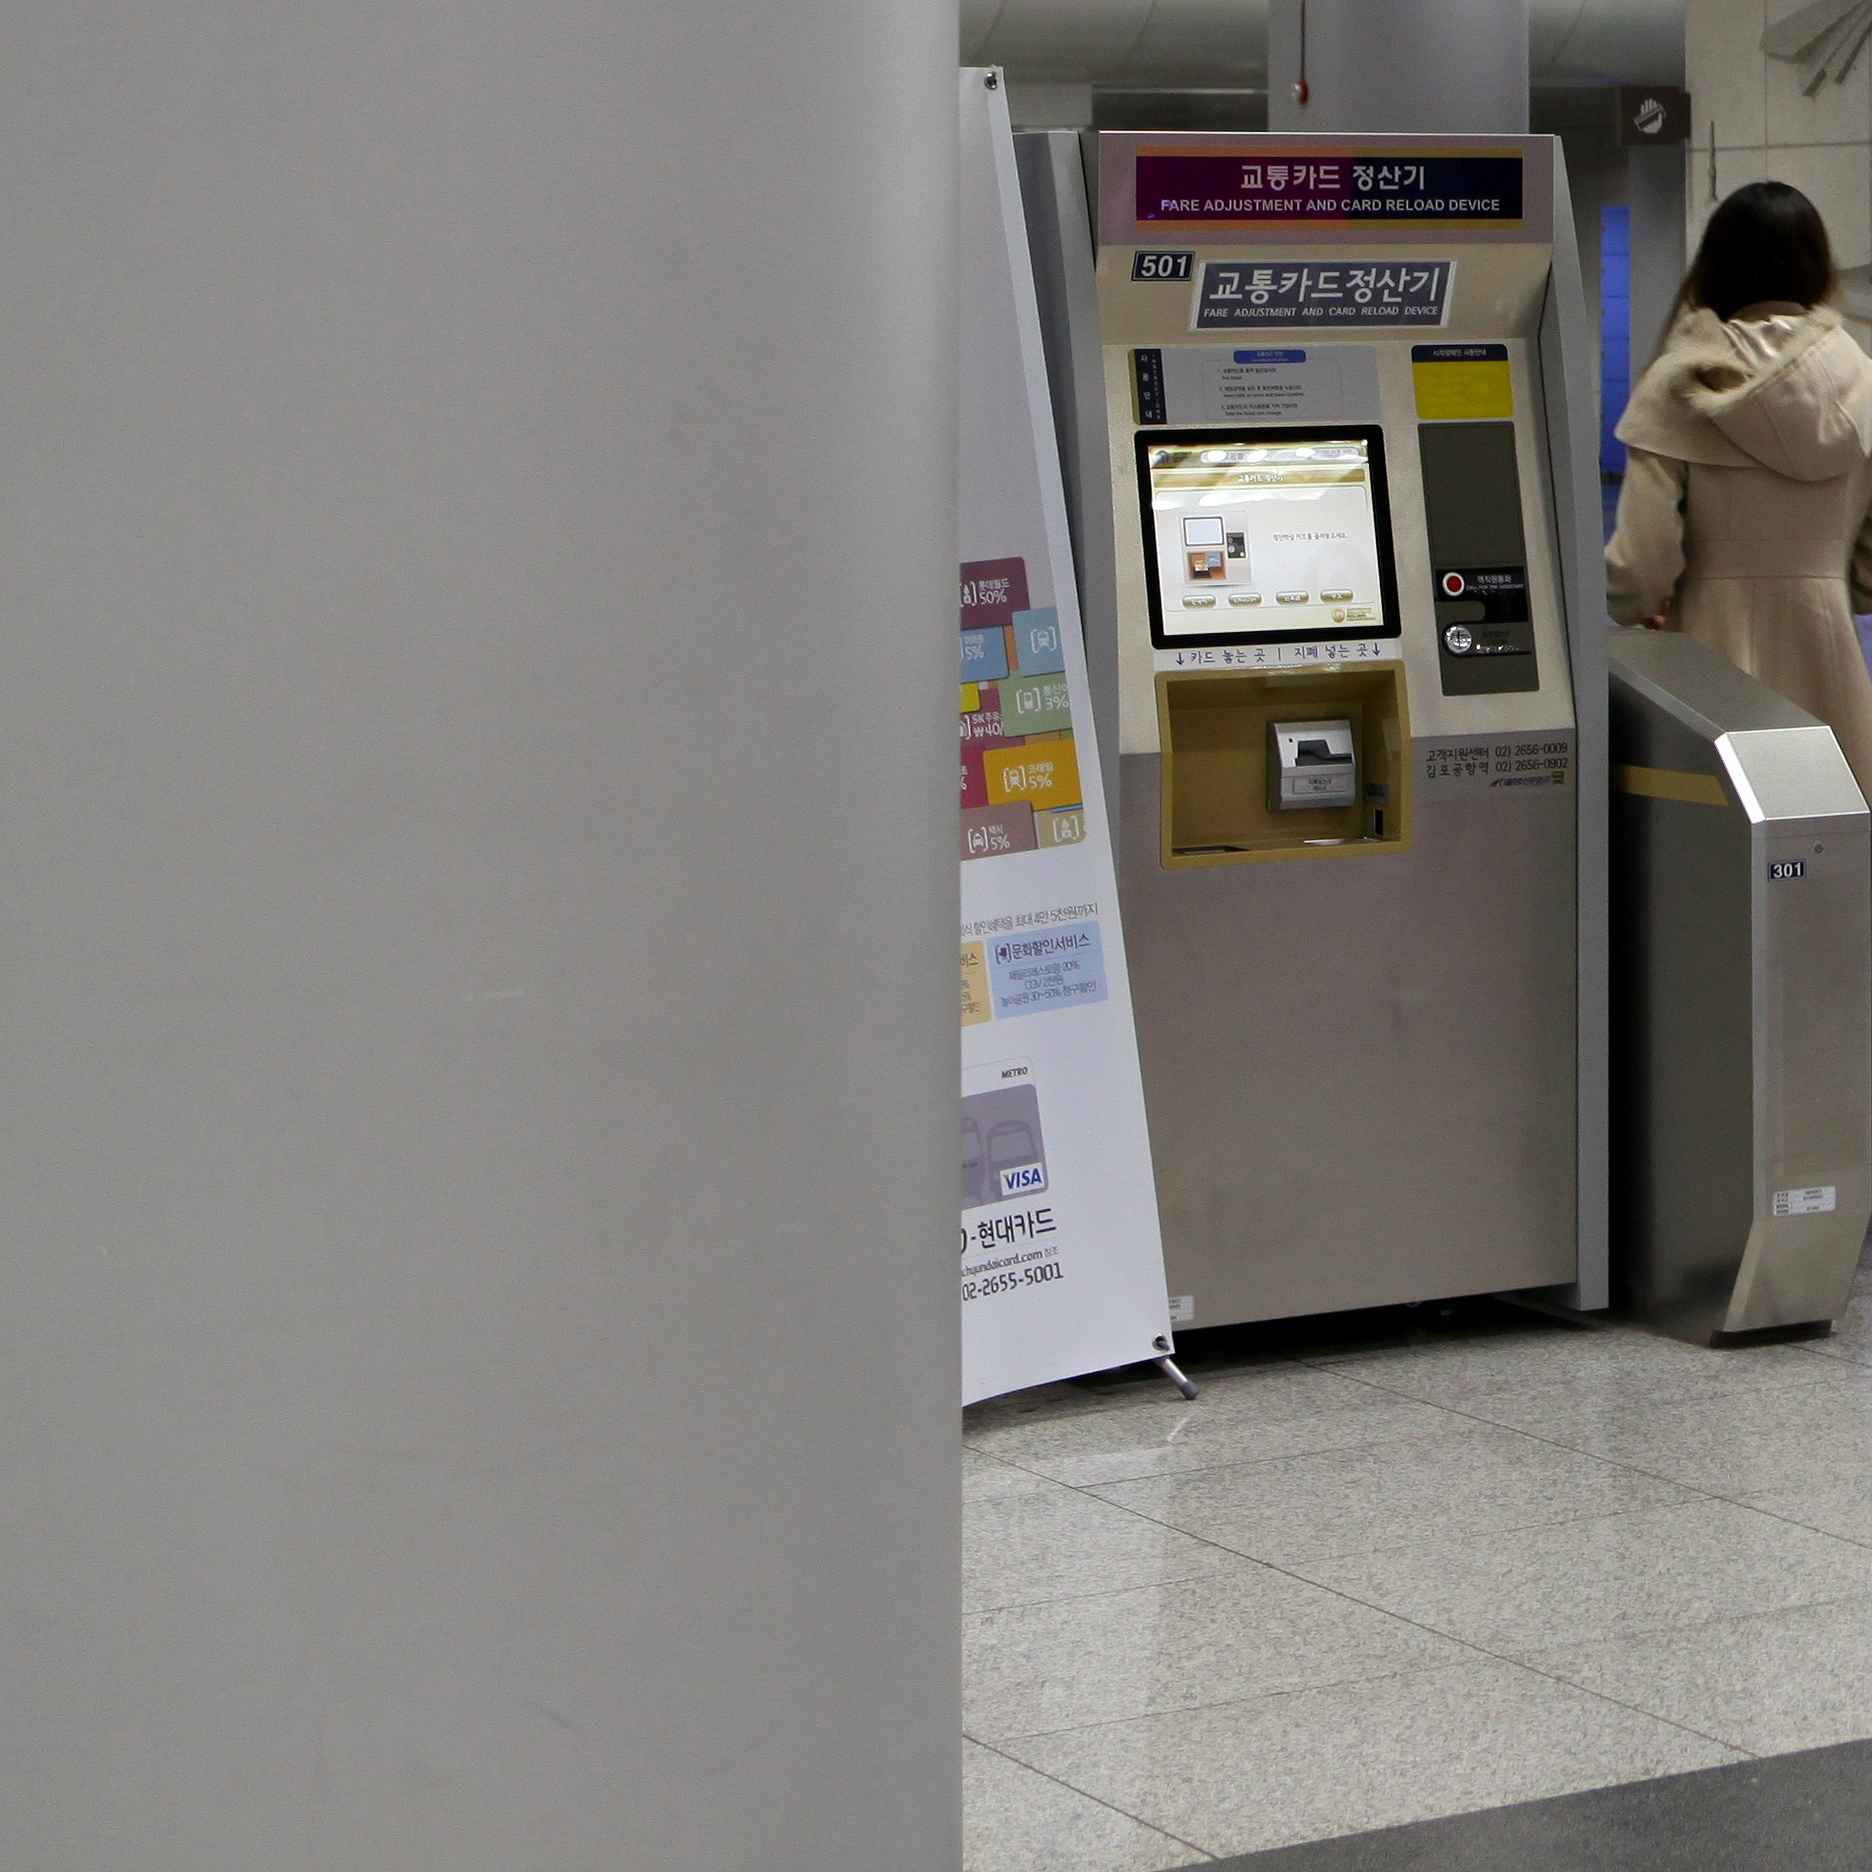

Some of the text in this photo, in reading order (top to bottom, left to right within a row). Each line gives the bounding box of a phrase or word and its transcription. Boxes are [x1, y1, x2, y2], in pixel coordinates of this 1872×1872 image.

[1240, 165, 1425, 192] 교통카드 정산기
[1161, 199, 1500, 212] FARE ADJUSTMENT AND CARD RELOAD DEVICE
[1141, 255, 1189, 277] 501
[1209, 269, 1439, 304] 교통카드정산기
[1204, 306, 1438, 319] FARE ADJUSTMENT AND CARD RELOAD DEVICE
[980, 589, 1007, 605] 50%
[1191, 648, 1265, 664] 카드 놓는 곳
[1294, 643, 1370, 659] 지폐 넣는 곳
[1045, 696, 1070, 711] 3%
[1495, 746, 1511, 758] 02)
[1496, 761, 1511, 773] 02)
[1028, 775, 1052, 790] 5%
[990, 834, 1010, 850] 5%
[1772, 862, 1802, 879] 301
[1012, 933, 1091, 960] 문화할인서비스
[1001, 1066, 1028, 1078] METRO
[1003, 1167, 1042, 1190] VISA
[962, 1262, 1064, 1302] 02-2655-5001
